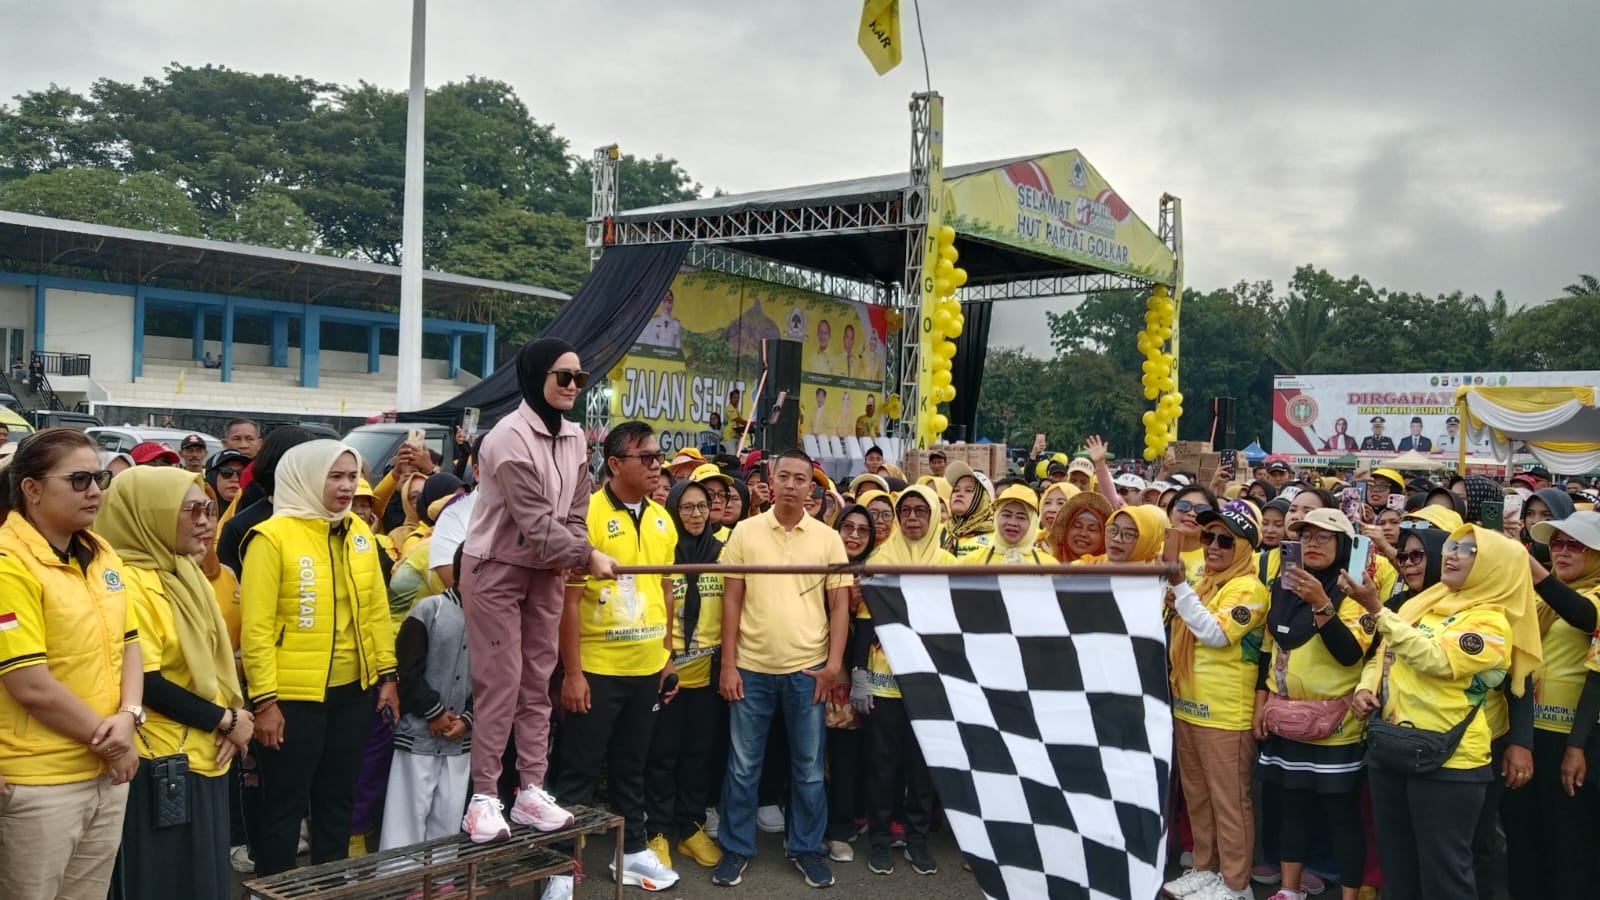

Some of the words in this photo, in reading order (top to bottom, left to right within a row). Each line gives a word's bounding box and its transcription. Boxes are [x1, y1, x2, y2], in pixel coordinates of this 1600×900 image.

[868, 20, 891, 48] KAR
[1018, 185, 1071, 219] SELAMAT
[1017, 213, 1042, 239] HUT
[1046, 223, 1084, 252] PARTAI
[1087, 235, 1128, 264] GOLKAR
[622, 368, 687, 421] JALAN
[689, 374, 746, 426] SEHAT
[1347, 391, 1457, 405] DIRGAHAY
[1358, 406, 1382, 415] DAN
[1384, 406, 1411, 415] HARI
[1413, 406, 1446, 415] GURU
[1222, 510, 1253, 531] ORT
[298, 555, 317, 628] GOLKAR
